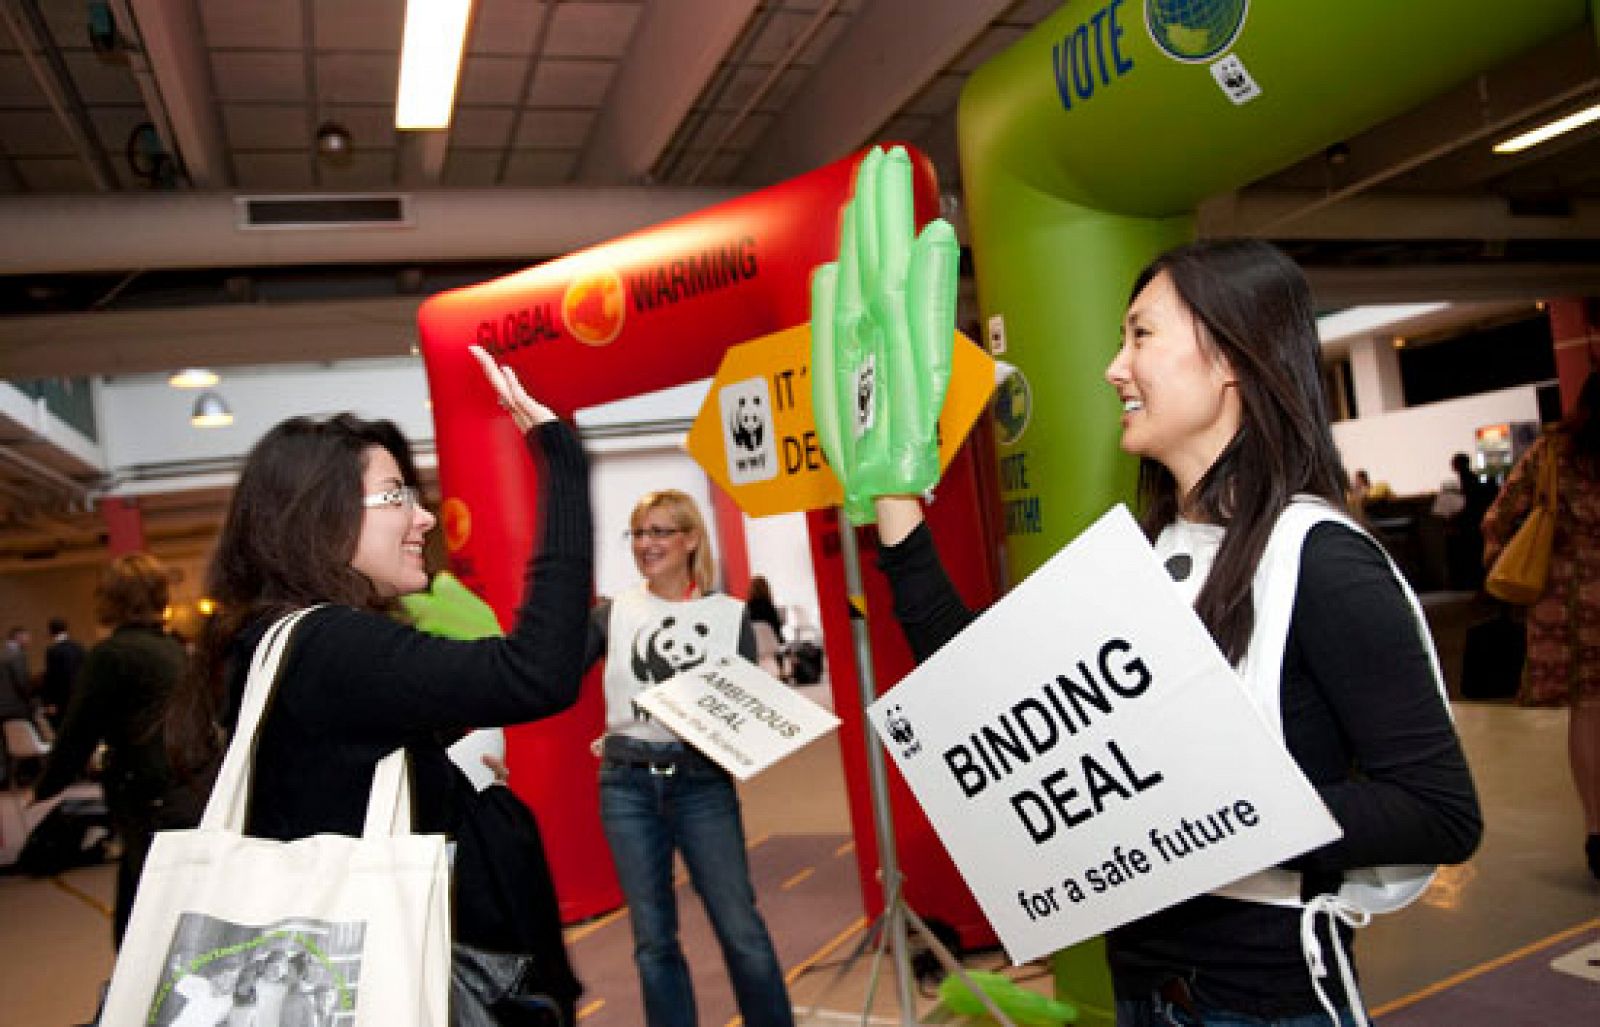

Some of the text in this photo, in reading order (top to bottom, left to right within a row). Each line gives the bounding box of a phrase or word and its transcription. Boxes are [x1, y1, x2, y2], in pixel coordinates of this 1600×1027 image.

[1052, 0, 1134, 111] VOTE
[476, 236, 758, 356] GLOBAL WARMING
[773, 366, 808, 411] IT'
[697, 694, 749, 734] DEAL
[698, 671, 801, 737] AMBITIOUS
[942, 637, 1153, 798] BINDING
[1009, 740, 1164, 845] DEAL
[1018, 799, 1260, 921] for a safe future
